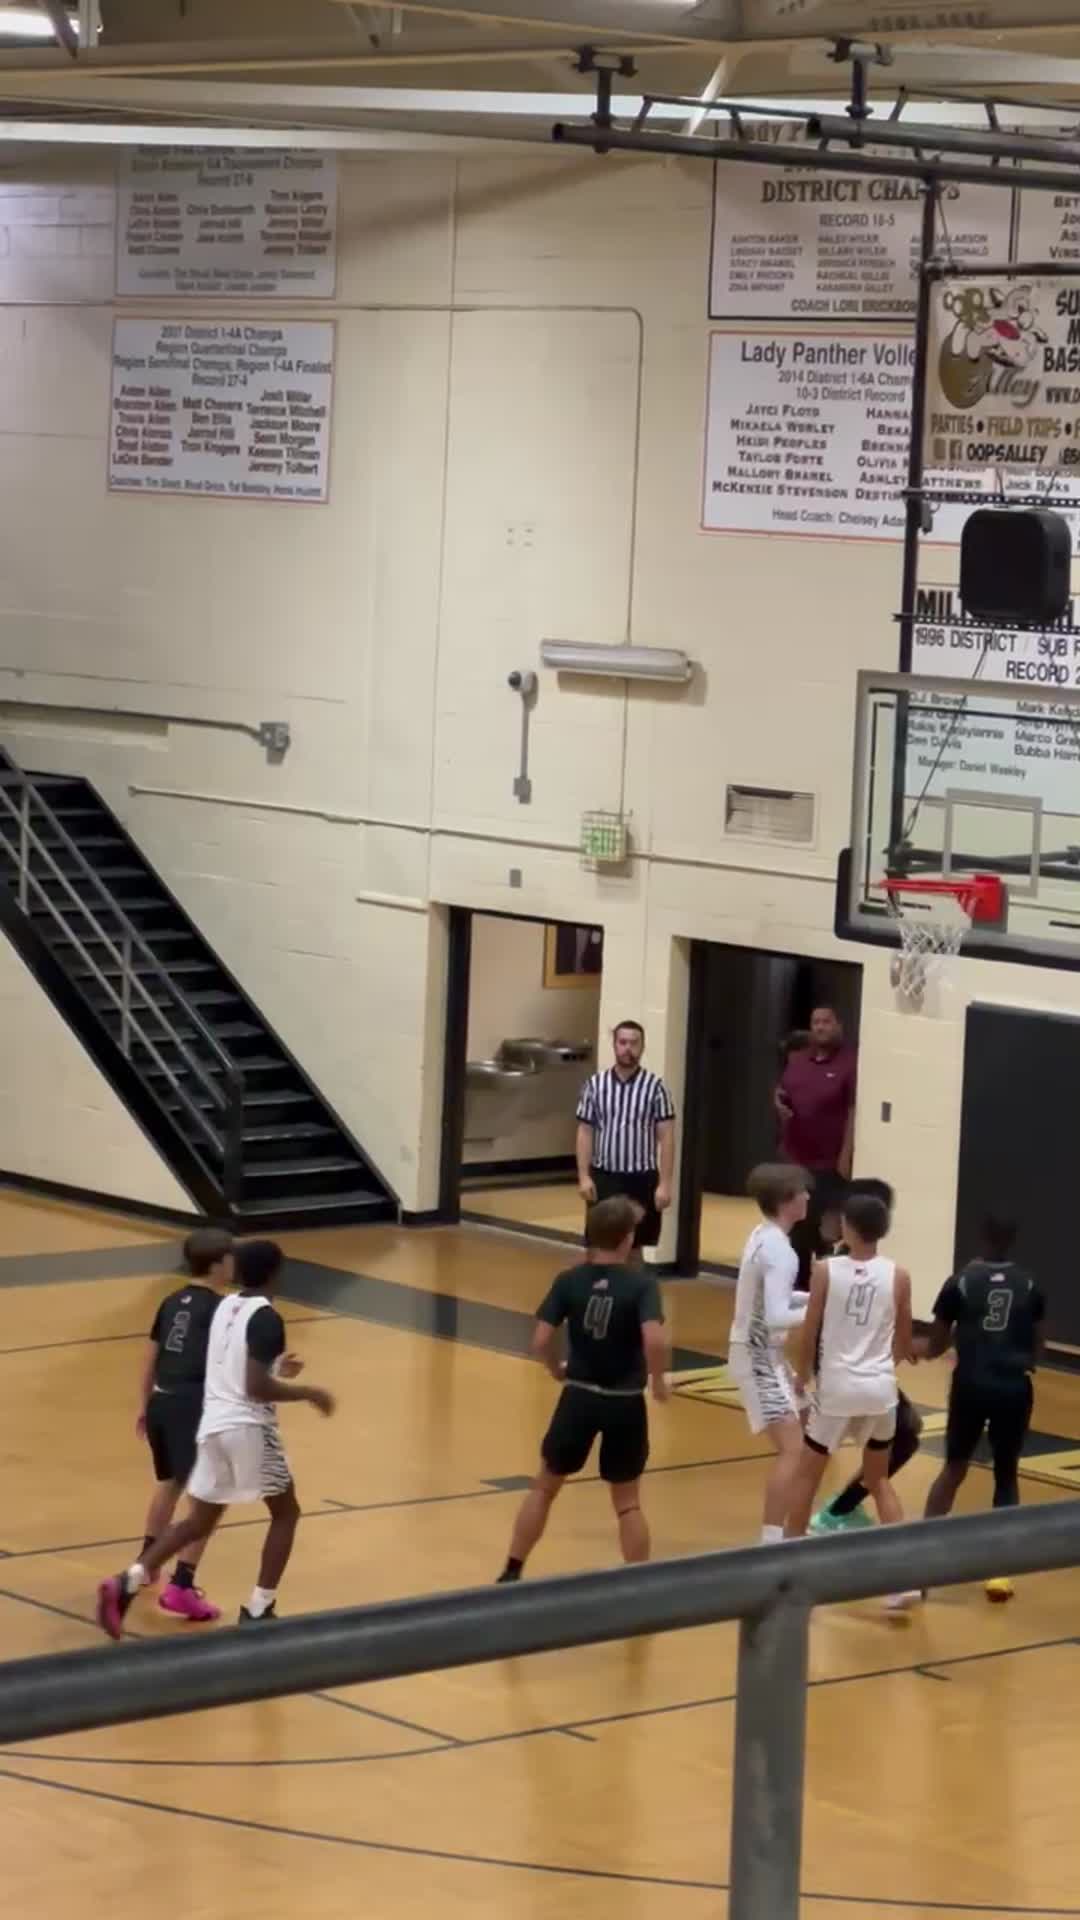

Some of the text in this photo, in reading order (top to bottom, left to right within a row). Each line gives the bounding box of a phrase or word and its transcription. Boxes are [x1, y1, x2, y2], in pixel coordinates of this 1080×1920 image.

[761, 180, 861, 203] DISTRICT
[820, 214, 869, 226] RECORD
[791, 299, 830, 312] COACH
[740, 341, 786, 367] Lady
[792, 342, 868, 368] Panther
[804, 372, 847, 385] District
[796, 387, 906, 403] 10-3 District Record
[931, 414, 973, 435] PARTIES
[988, 416, 1023, 437] FIELD
[1028, 417, 1063, 437] TRIPS
[967, 443, 1048, 462] OOPSALLEY
[921, 474, 982, 489] ATTHEWS
[916, 628, 945, 646] 1996
[951, 630, 1018, 652] DISTRICT
[1038, 637, 1068, 656] SUB
[1006, 661, 1069, 684] RECORD
[846, 1283, 876, 1326] 4
[983, 1289, 1013, 1331] 3
[584, 1295, 614, 1340] 4
[166, 1311, 190, 1352] 2
